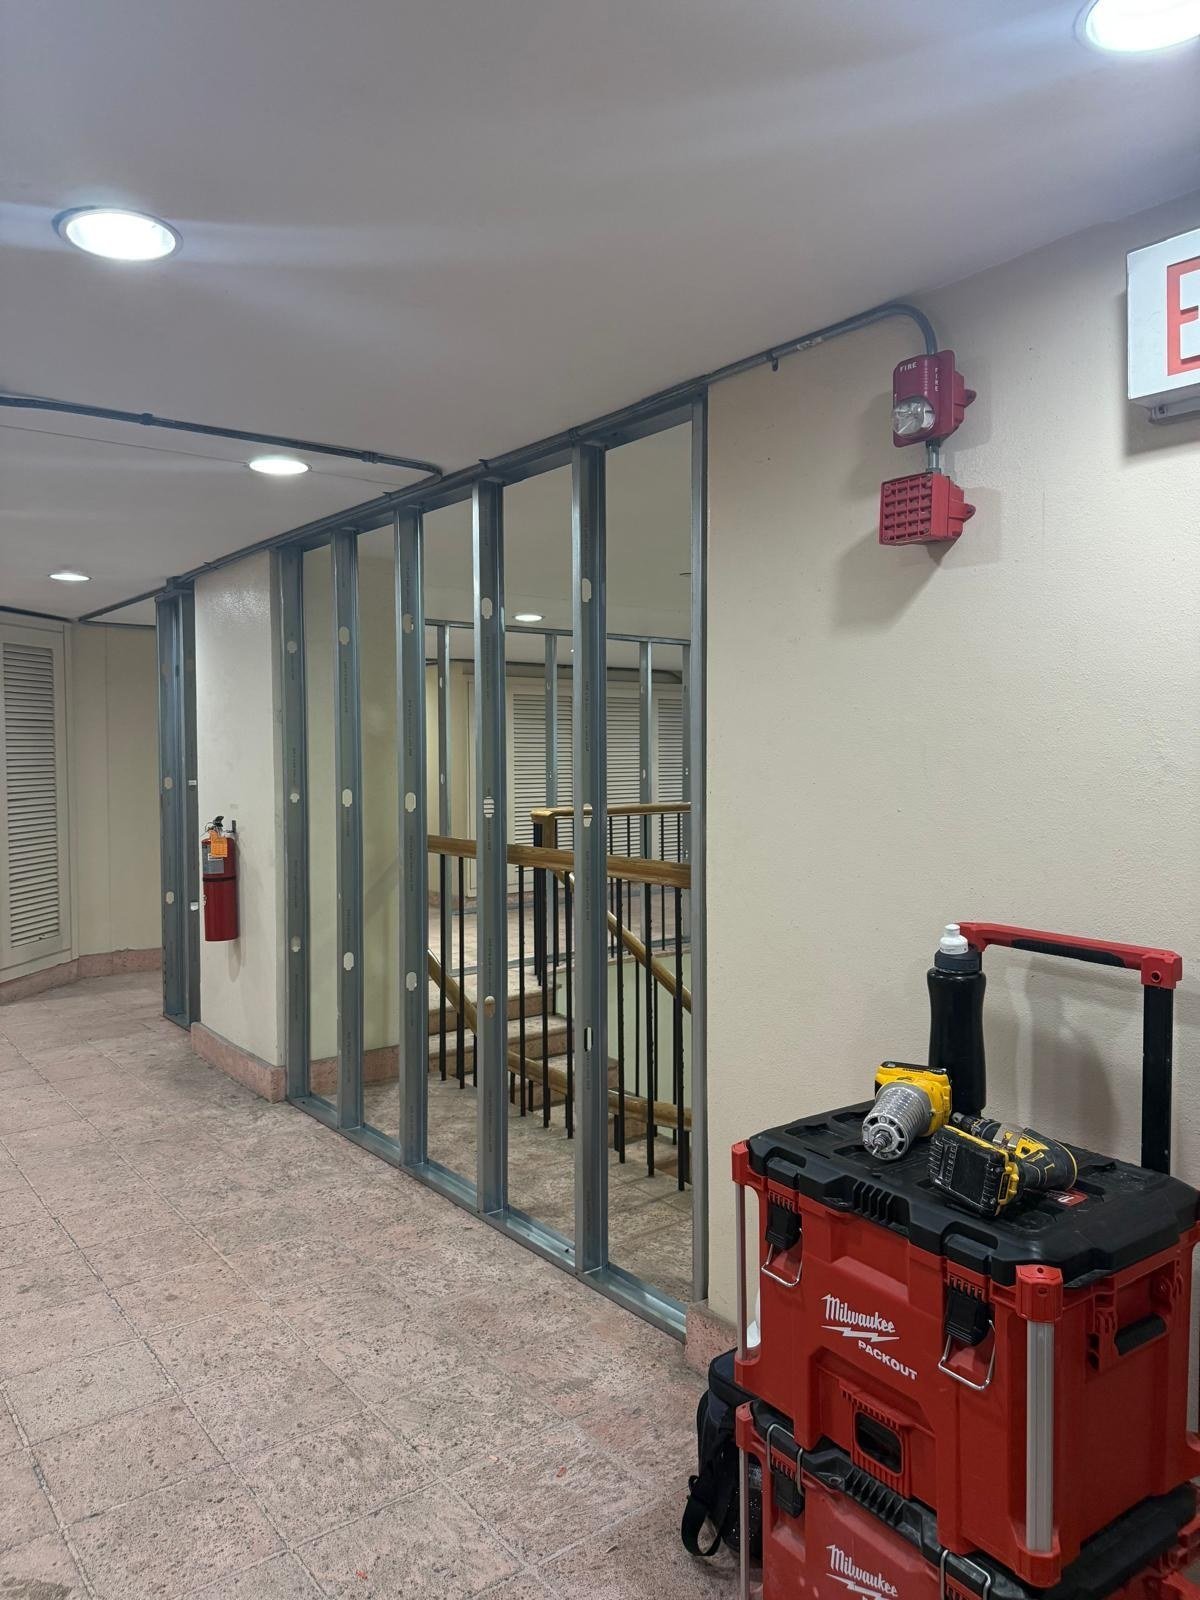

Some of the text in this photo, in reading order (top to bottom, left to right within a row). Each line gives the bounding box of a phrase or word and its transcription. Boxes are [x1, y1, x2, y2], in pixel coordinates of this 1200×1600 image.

[900, 361, 918, 372] FIRE
[821, 1294, 897, 1334] Milwaukee
[857, 1340, 919, 1381] PACKOUT
[825, 1544, 899, 1597] Milwaukee
